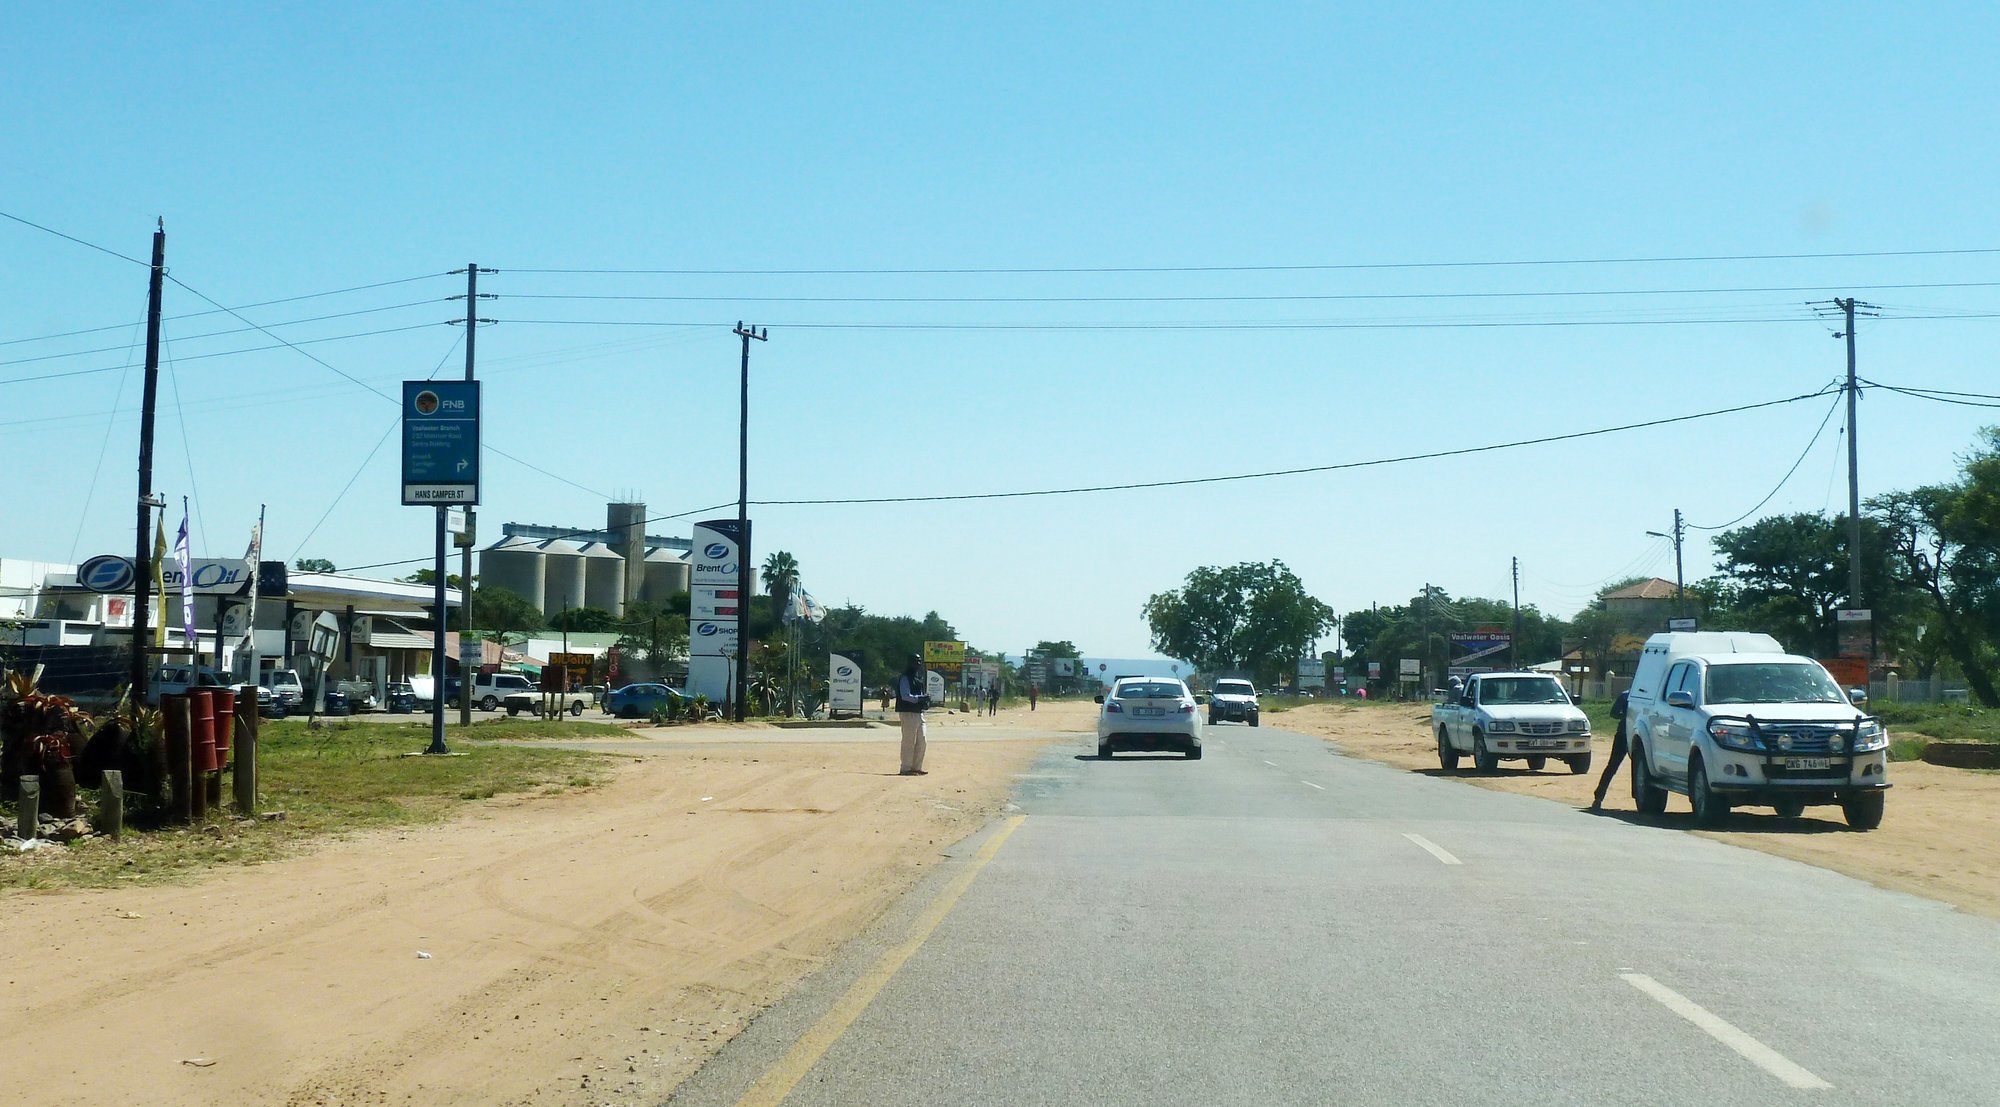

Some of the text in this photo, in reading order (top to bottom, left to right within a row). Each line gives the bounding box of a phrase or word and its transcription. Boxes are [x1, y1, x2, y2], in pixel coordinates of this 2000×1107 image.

[442, 400, 465, 409] FNB
[414, 490, 465, 499] HANS CAMPER ST
[696, 564, 721, 572] Brent
[192, 564, 240, 588] Oil
